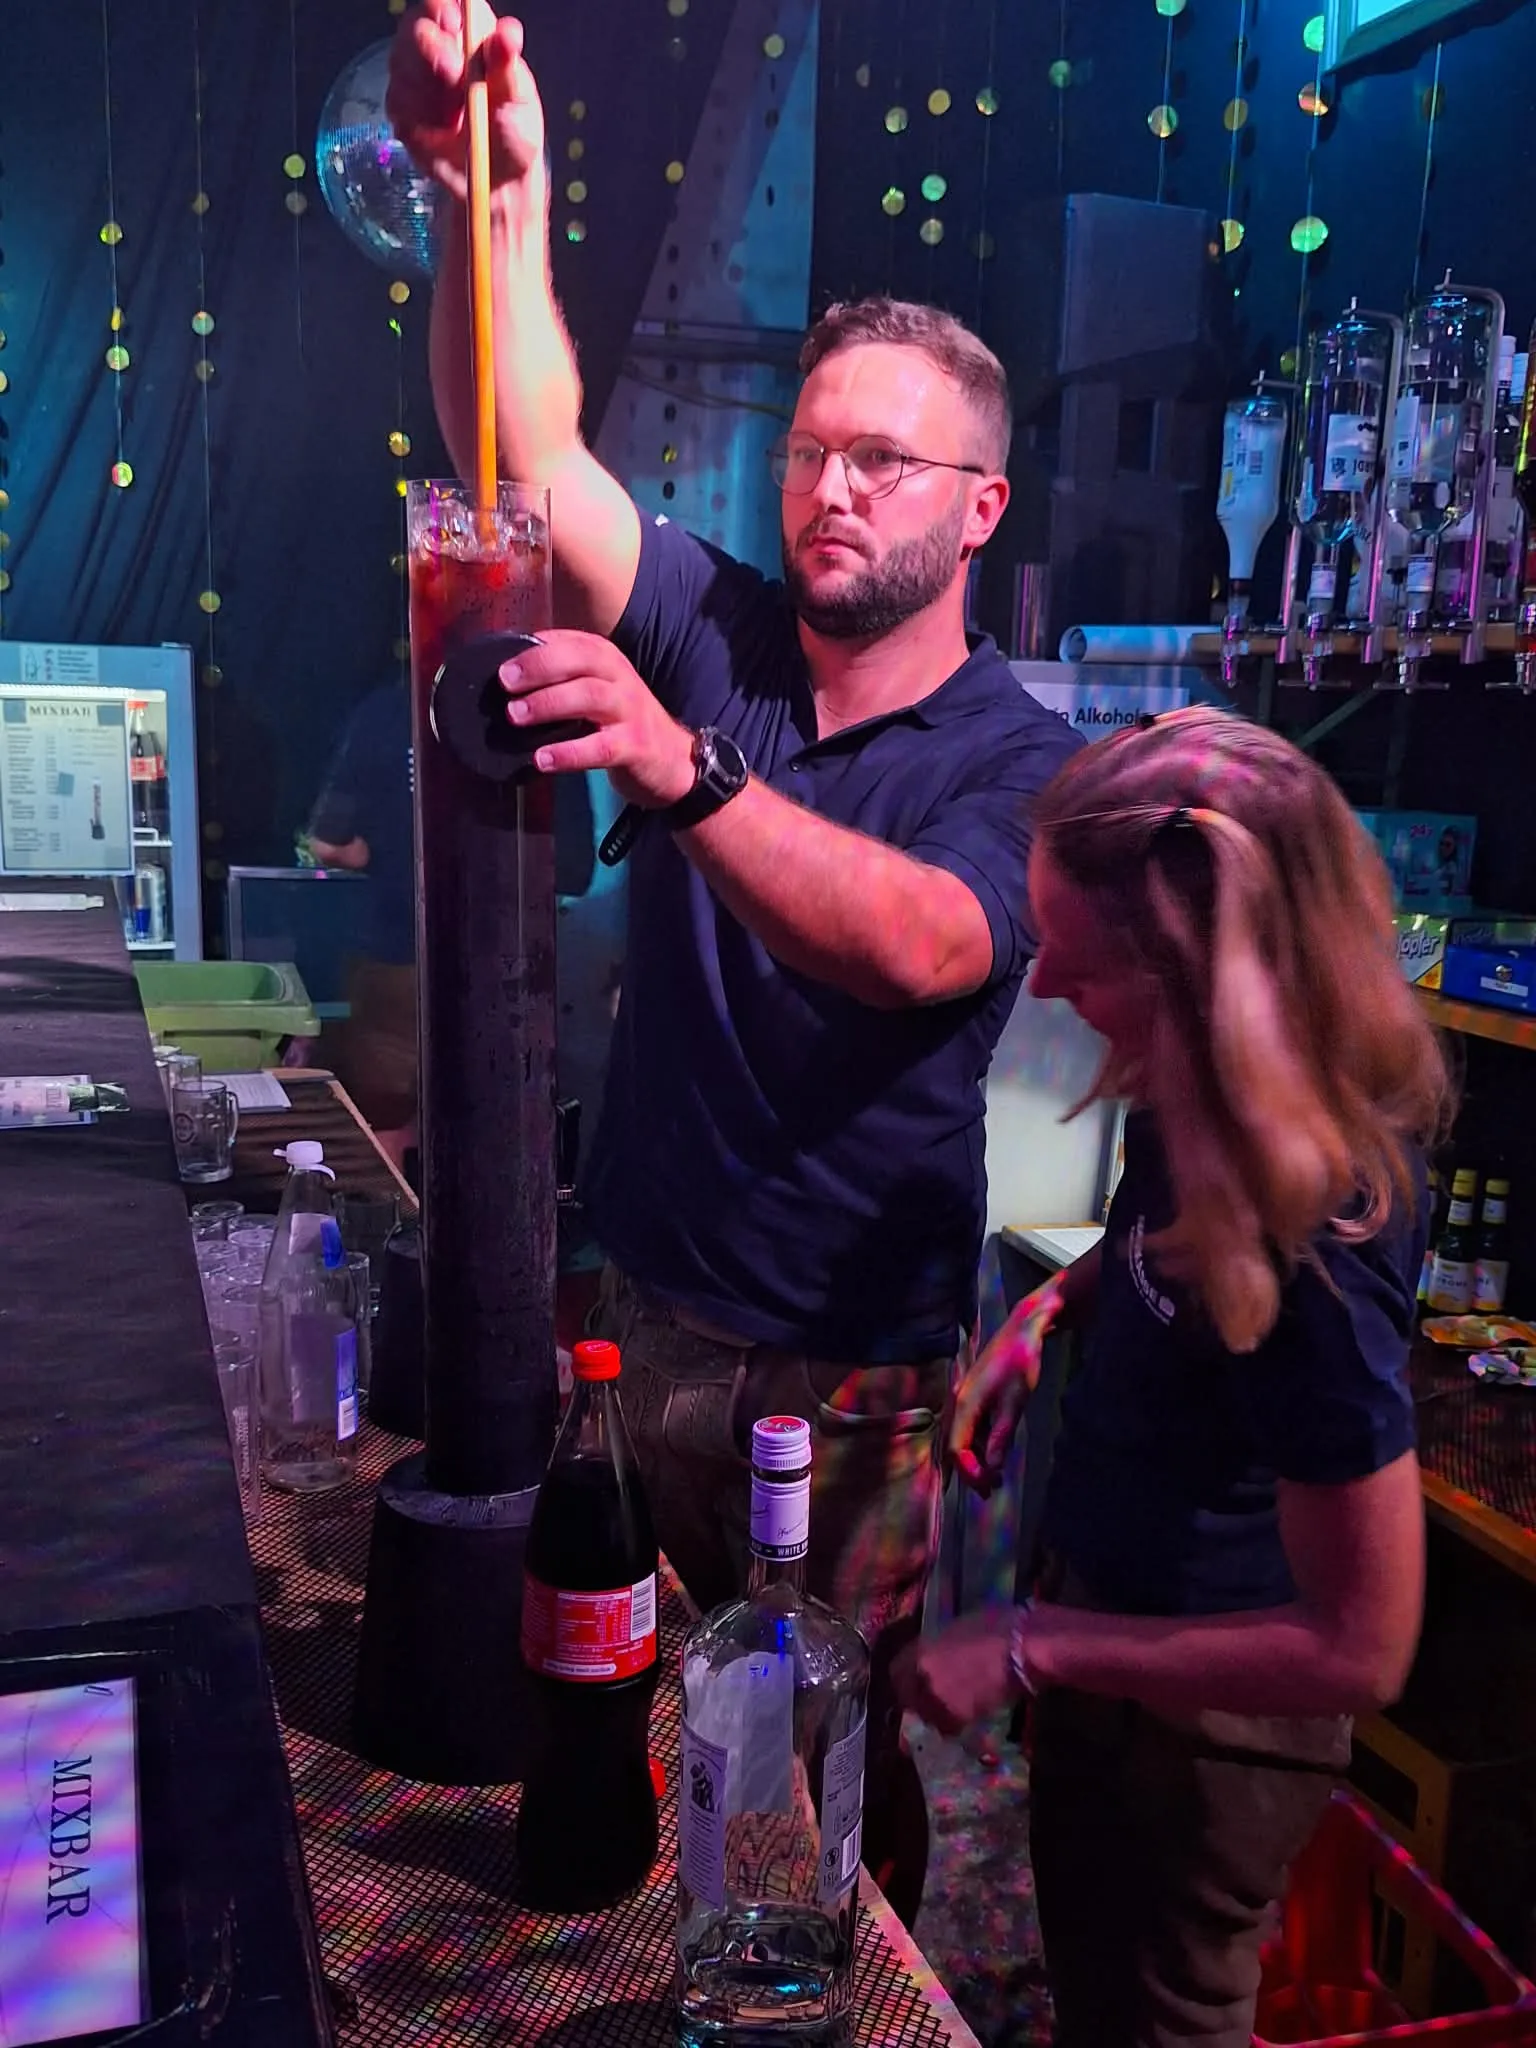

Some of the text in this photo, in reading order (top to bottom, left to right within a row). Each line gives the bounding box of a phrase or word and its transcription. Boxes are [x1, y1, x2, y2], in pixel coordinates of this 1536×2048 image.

[1396, 929, 1440, 960] lopfer
[777, 1544, 801, 1557] WHITE
[46, 1755, 93, 1925] MIXBAR
